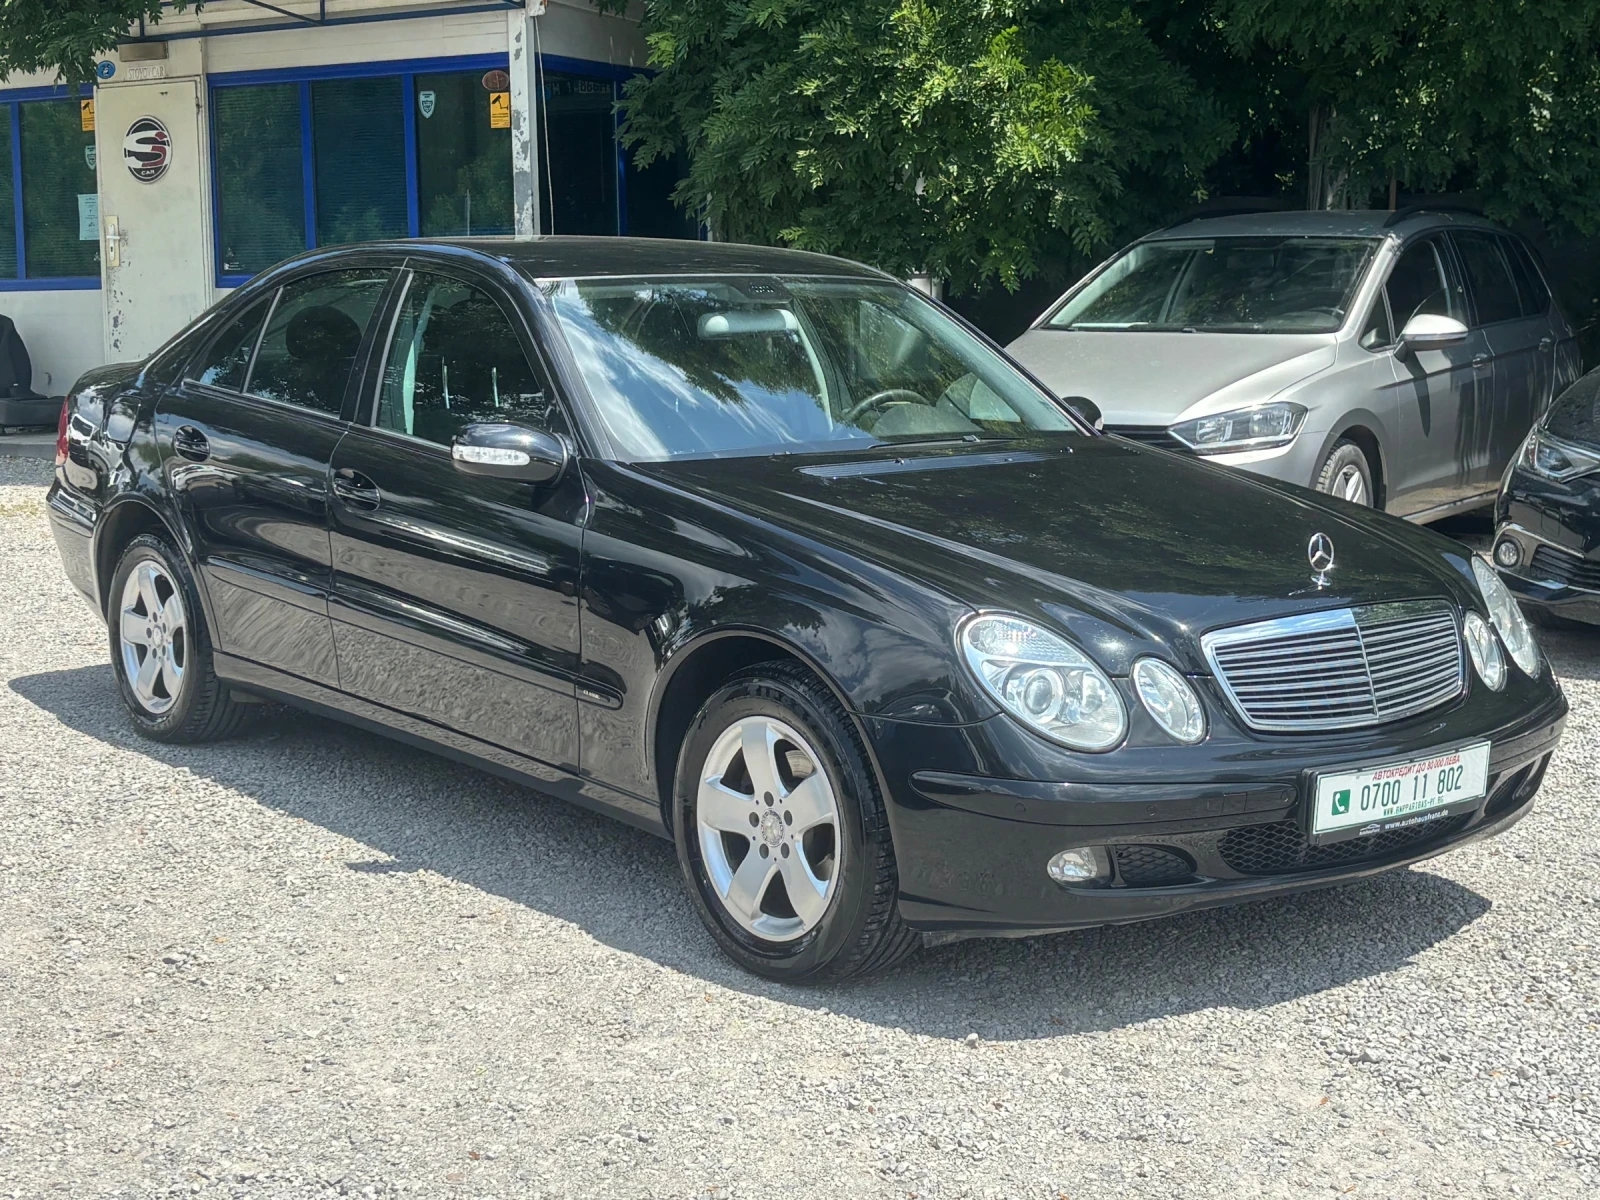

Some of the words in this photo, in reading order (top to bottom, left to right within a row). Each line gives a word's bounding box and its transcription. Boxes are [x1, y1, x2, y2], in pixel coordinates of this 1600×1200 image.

[152, 66, 164, 77] CAR
[1372, 764, 1417, 781] АВТОКРЕДИТ
[1416, 762, 1427, 774] ДО
[1444, 755, 1461, 767] ЛЕВА
[1360, 779, 1400, 811] 0700
[1413, 773, 1428, 801] 11
[1437, 765, 1464, 795] 802
